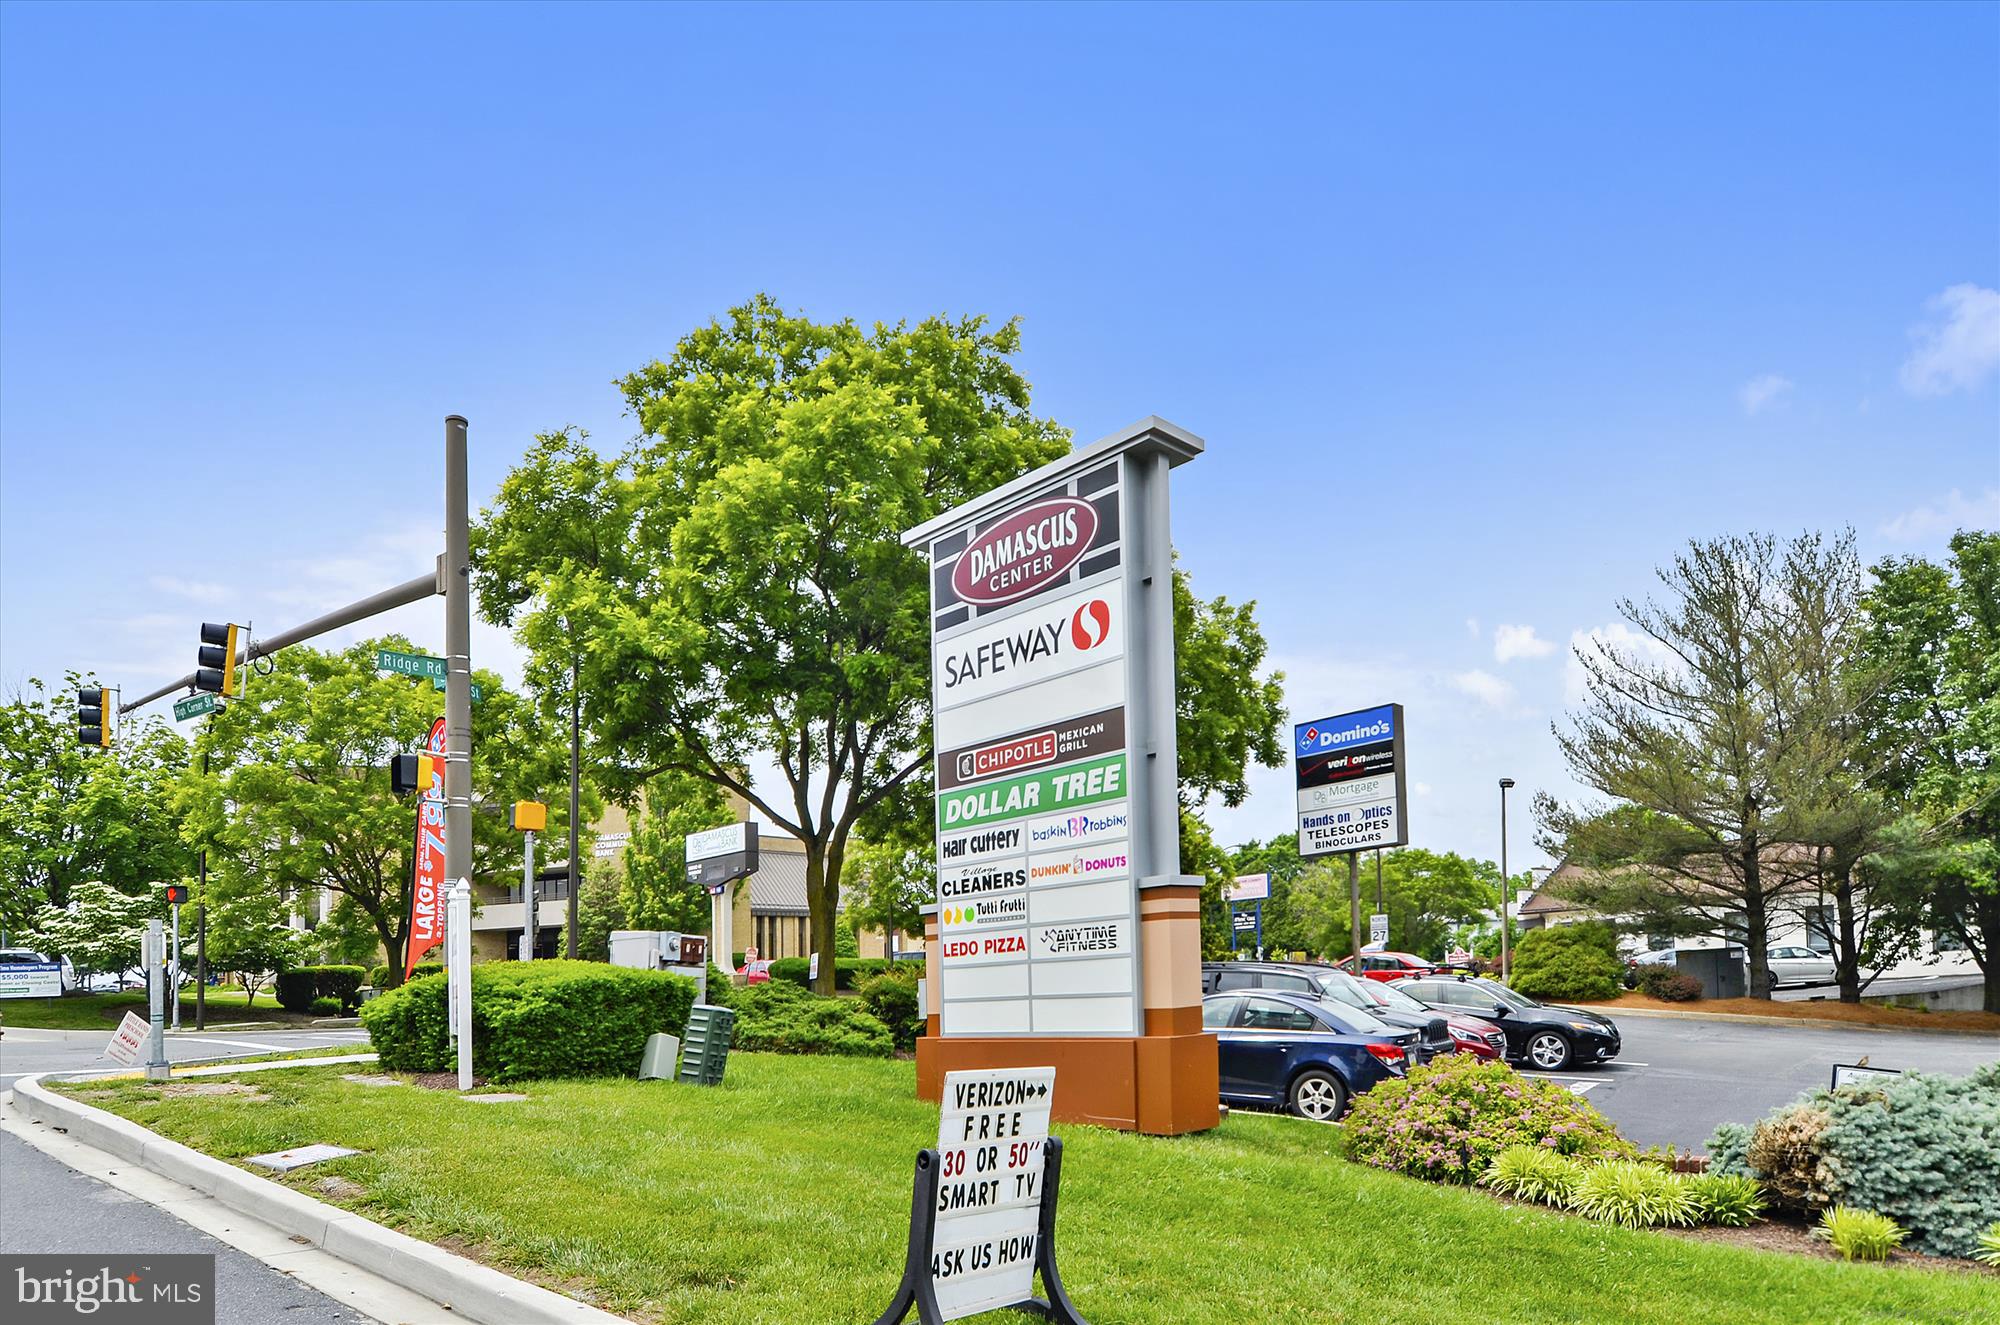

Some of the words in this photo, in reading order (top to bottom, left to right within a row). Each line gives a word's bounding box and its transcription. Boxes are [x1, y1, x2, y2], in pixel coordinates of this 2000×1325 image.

[971, 508, 1078, 586] DAMASCUS
[990, 554, 1053, 592] CENTER
[945, 618, 1066, 688] SAFEWAY
[384, 654, 419, 673] Ridge
[427, 661, 442, 675] Rd
[175, 706, 186, 718] High
[187, 702, 203, 713] Corner
[1320, 720, 1390, 746] Domino's
[978, 739, 1052, 770] CHIPOTLE
[1059, 723, 1104, 742] MEXICAN
[1060, 740, 1088, 753] GRILL
[945, 781, 1040, 824] DOLLAR
[1052, 764, 1121, 802] TREE
[1329, 780, 1378, 796] Mortgage
[1302, 814, 1334, 828] Hands
[1338, 812, 1350, 823] on
[1352, 806, 1392, 820] Optics
[1308, 819, 1389, 840] TELESCOPES
[1316, 832, 1382, 849] BINOCULARS
[962, 866, 998, 877] Village
[1032, 864, 1071, 878] DUNKIN'
[1086, 856, 1126, 872] DONUTS
[942, 870, 1026, 896] CLEANERS
[416, 876, 435, 940] LARGE
[976, 900, 998, 916] Tutti
[1056, 925, 1117, 942] ANYTIME
[1372, 930, 1386, 941] 27
[944, 940, 978, 958] LEDO
[984, 936, 1026, 954] PIZZA
[1057, 938, 1117, 952] FITNESS
[956, 1080, 1026, 1109] VERIZON
[964, 1112, 1022, 1140] FREE
[944, 1150, 965, 1178] 30
[976, 1146, 998, 1172] OR
[938, 1180, 999, 1212] SMART
[1016, 1172, 1036, 1198] TV
[932, 1248, 964, 1279] ASK
[972, 1242, 992, 1270] US
[998, 1235, 1034, 1265] HOW
